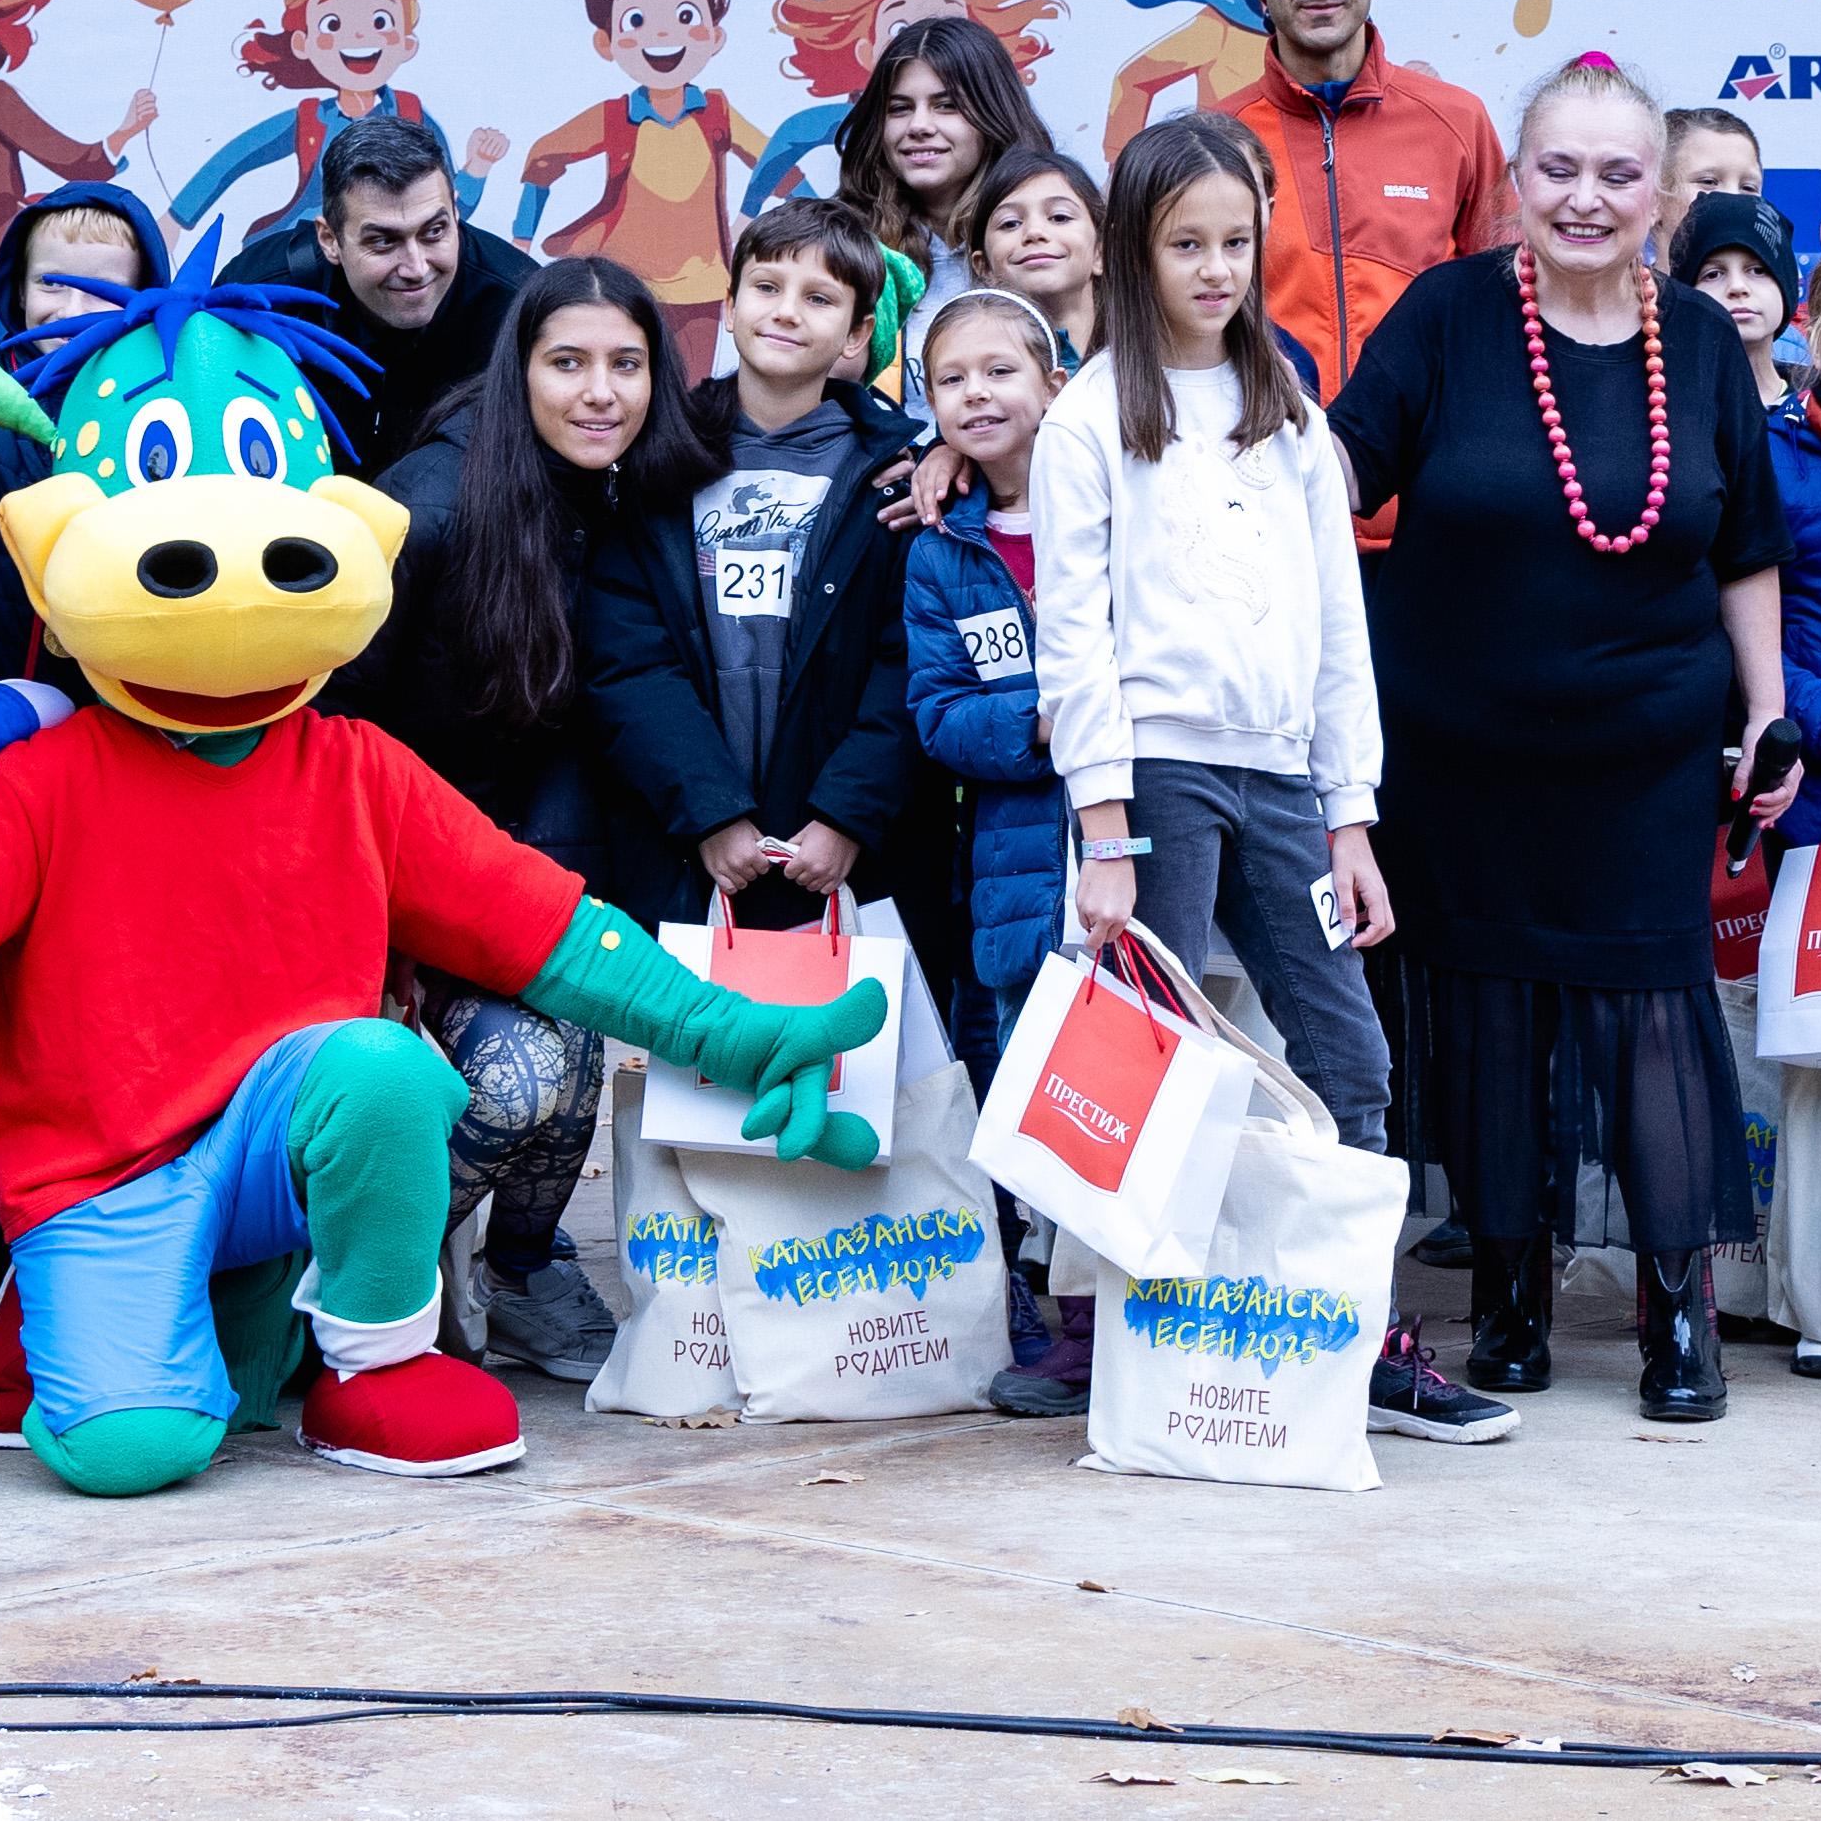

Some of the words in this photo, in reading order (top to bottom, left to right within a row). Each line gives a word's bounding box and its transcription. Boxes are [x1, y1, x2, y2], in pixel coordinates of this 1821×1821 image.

[723, 562, 786, 600] 231
[963, 621, 1024, 667] 288
[1714, 909, 1770, 940] ПРЕС
[1042, 1070, 1132, 1146] ПРЕСТИЖ
[748, 1205, 981, 1275] КАЛПАЗАНСКА
[653, 1252, 716, 1284] ЕСЕ
[795, 1267, 879, 1306] ЕСЕН
[889, 1253, 957, 1290] 2025
[1126, 1277, 1362, 1324] КАЛПАЗАНСКА
[847, 1309, 931, 1347] НОВИТЕ
[1154, 1316, 1237, 1356] ЕСЕН
[1243, 1330, 1318, 1365] 2025
[1189, 1382, 1271, 1415] НОВИТЕ
